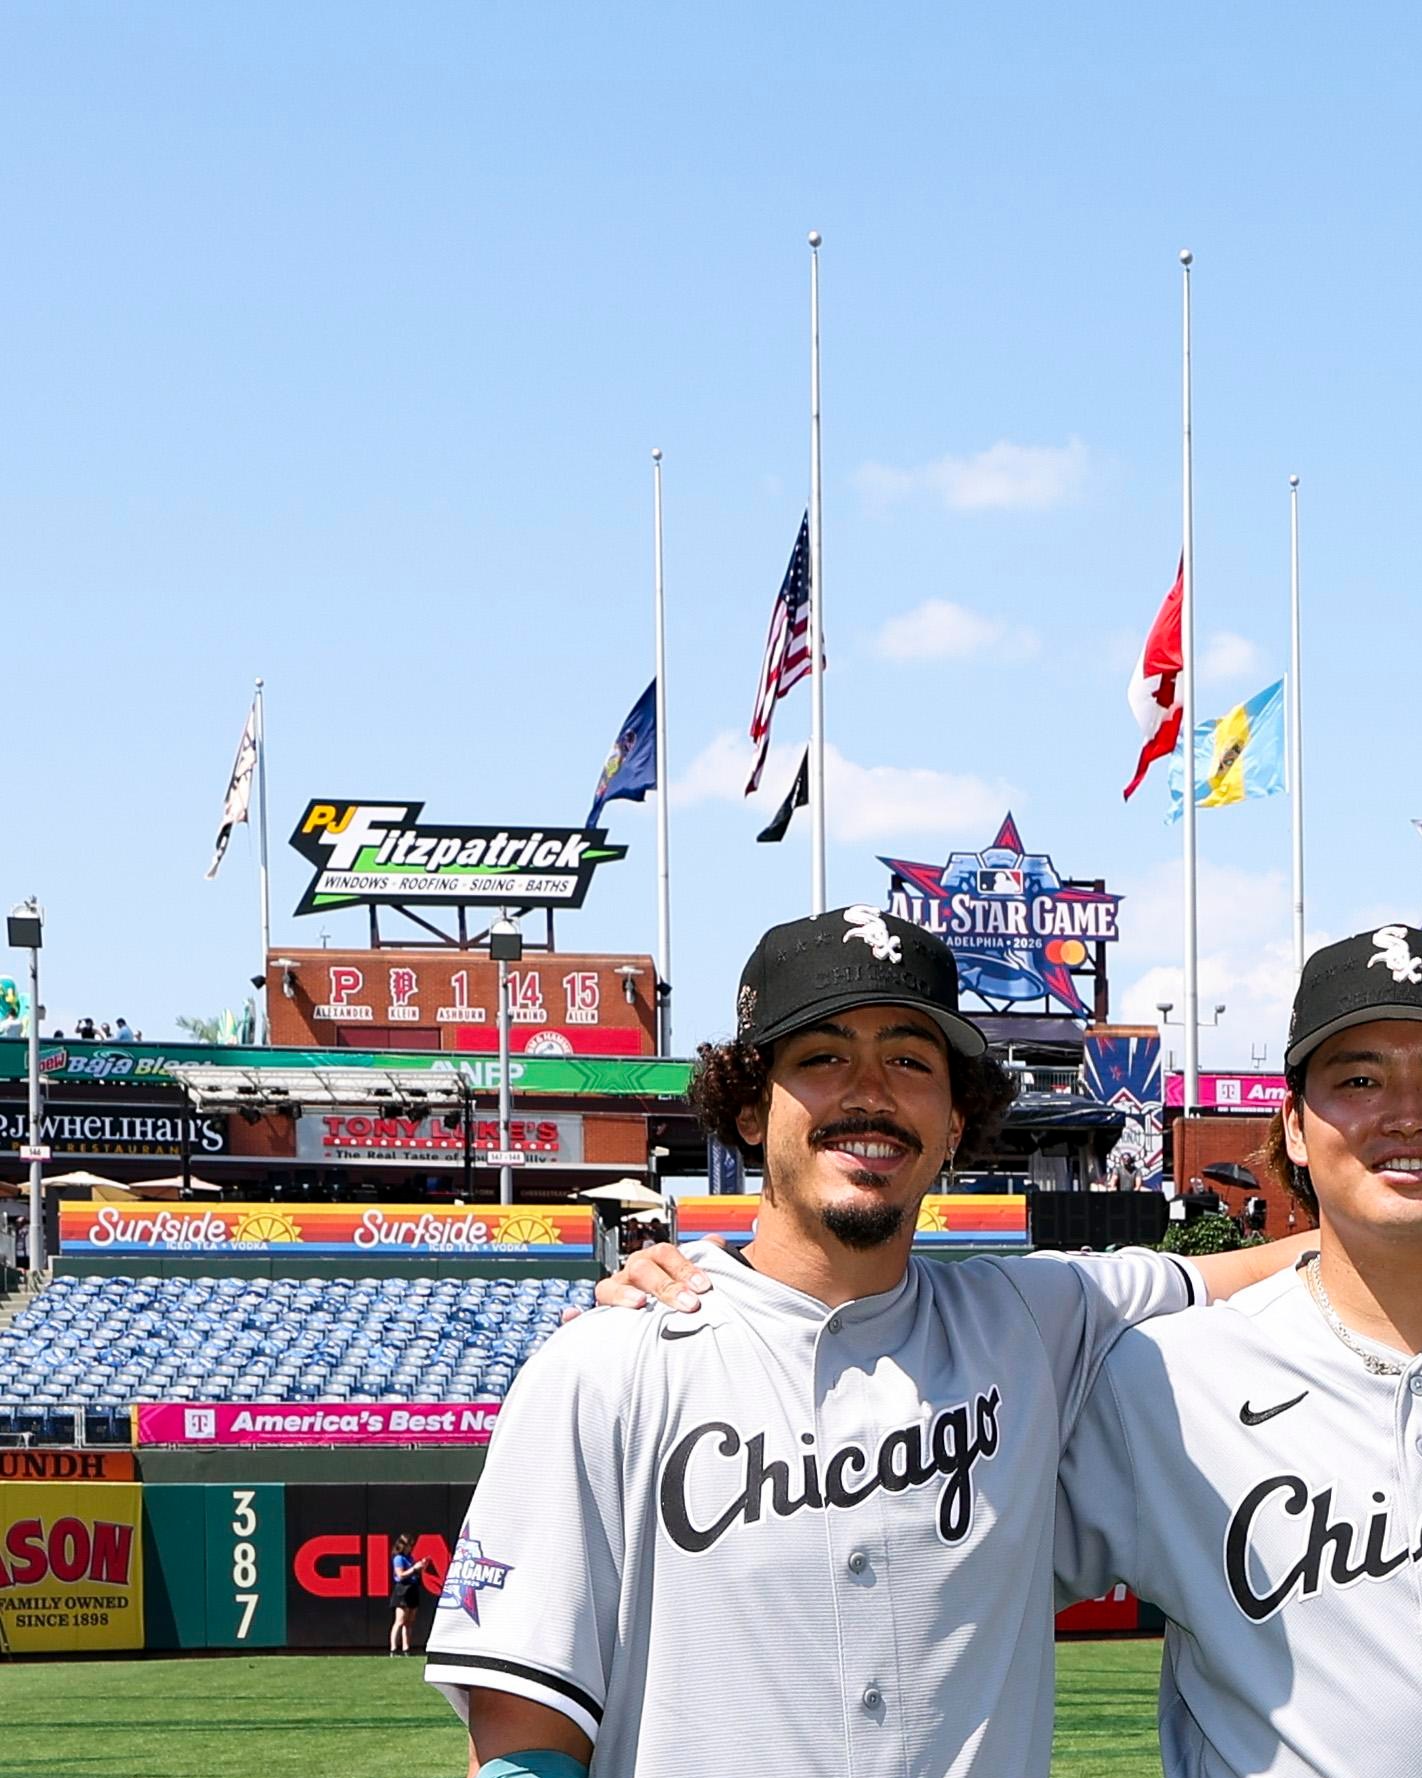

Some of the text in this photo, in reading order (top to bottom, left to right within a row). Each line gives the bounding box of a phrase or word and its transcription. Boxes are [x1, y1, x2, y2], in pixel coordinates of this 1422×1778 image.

[302, 805, 357, 834] PJ
[318, 806, 591, 872] Fitzpatrick
[323, 876, 570, 893] WINDOWS ROOFING SIDING BATHS
[892, 892, 1116, 937] ALL STAR GAME
[945, 938, 1043, 949] ADELPHIA 2026
[329, 967, 363, 1006] P
[452, 970, 468, 1009] 1
[507, 971, 542, 1009] 14
[563, 972, 599, 1010] 15
[314, 1006, 372, 1020] ALEXANDER
[390, 1007, 418, 1019] KLEIN
[438, 1008, 485, 1021] ASHBURN
[509, 1009, 546, 1022] NNING
[567, 1010, 597, 1023] ALLEN
[67, 1052, 132, 1078] Baja
[1247, 1084, 1285, 1100] Am
[323, 1116, 419, 1139] TONY
[67, 1142, 182, 1155] RESTAURAN
[336, 1150, 361, 1159] The
[367, 1150, 397, 1160] Real
[403, 1151, 440, 1161] Taste
[445, 1152, 459, 1161] of
[89, 1206, 227, 1247] Surfside
[354, 1208, 487, 1248] Surfside
[165, 1241, 192, 1250] ICED
[196, 1241, 218, 1251] TEA
[231, 1241, 269, 1251] VODKA
[428, 1242, 454, 1252] ICED
[458, 1243, 480, 1252] TEA
[492, 1243, 529, 1253] VODKA
[230, 1410, 383, 1433] America's
[389, 1411, 456, 1433] Best
[460, 1411, 497, 1433] Ne
[658, 1384, 1002, 1556] Chicago
[294, 1534, 453, 1597] GIA
[462, 1559, 506, 1585] GAME
[64, 1596, 129, 1610] OWNED
[16, 1613, 109, 1628] SINCE 1898
